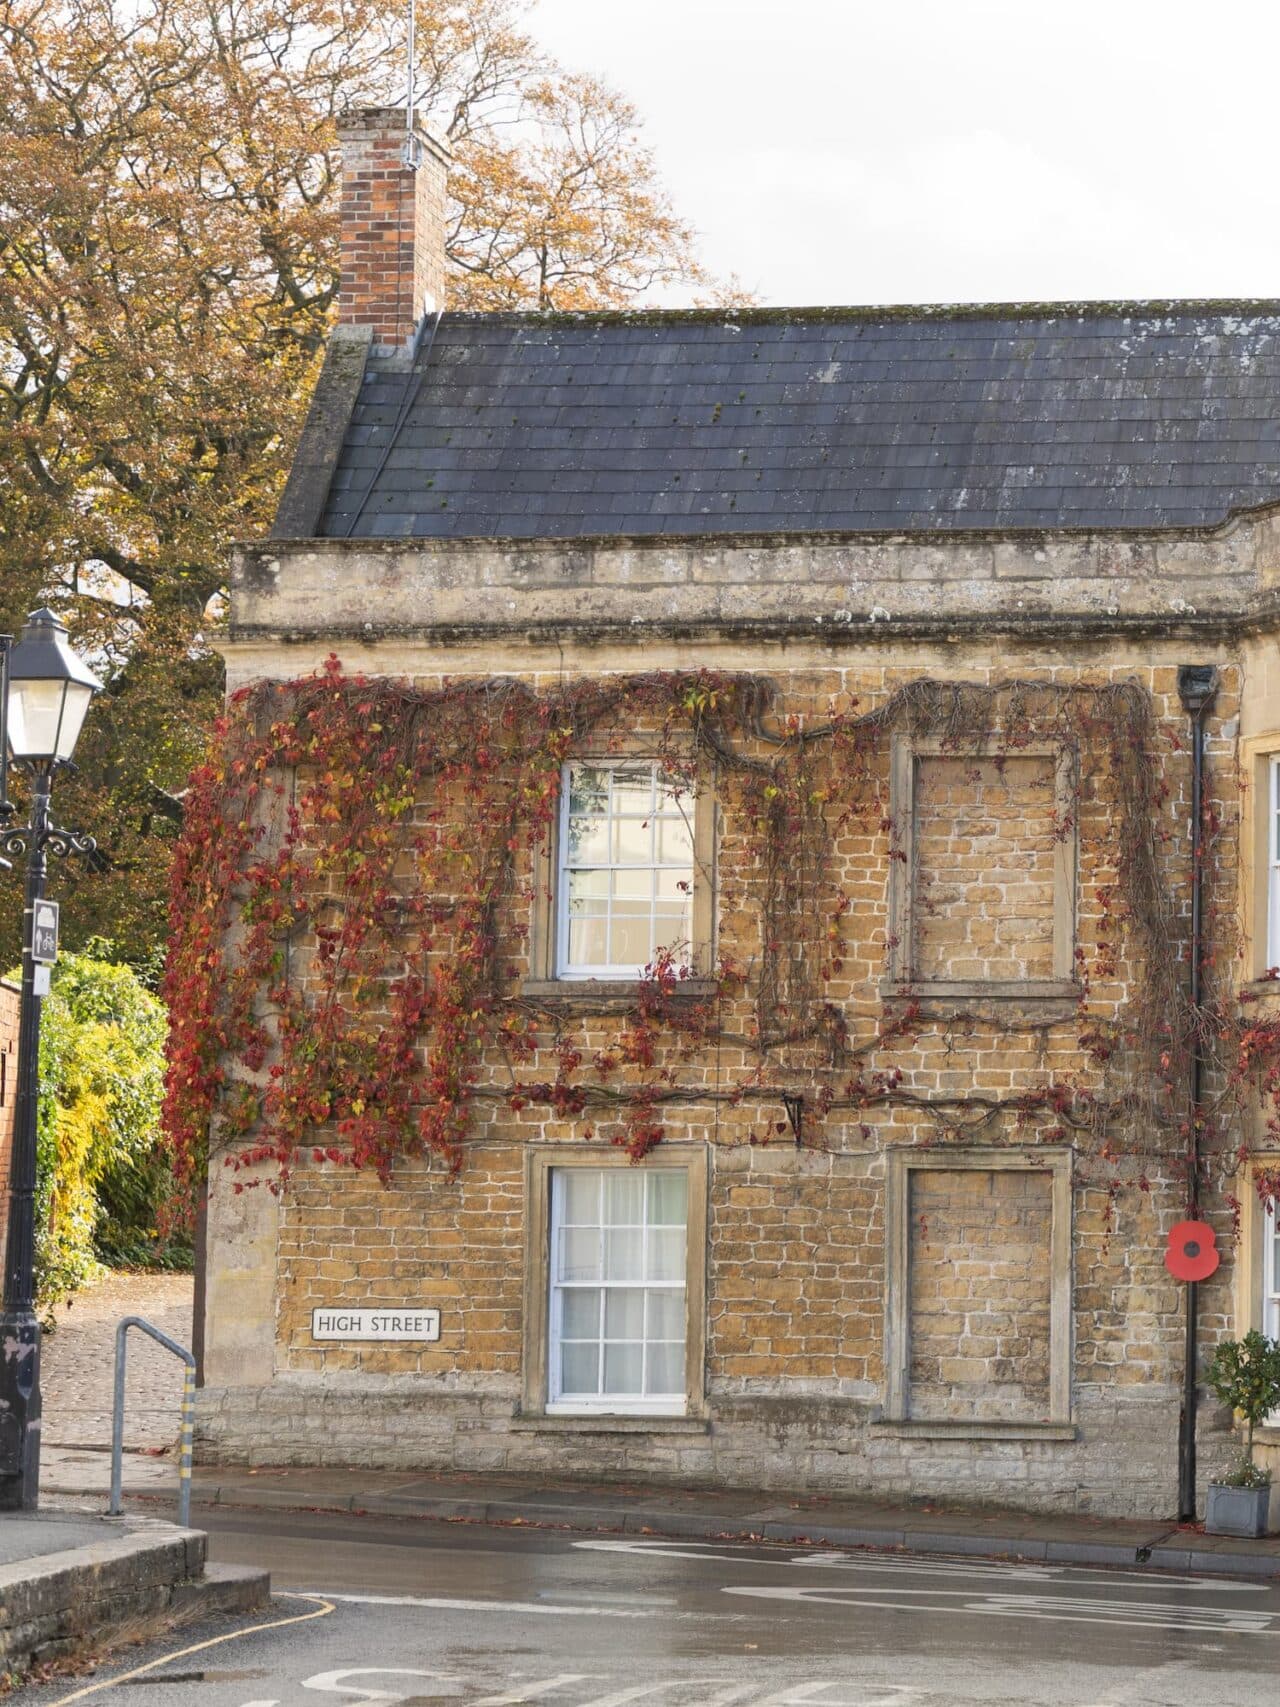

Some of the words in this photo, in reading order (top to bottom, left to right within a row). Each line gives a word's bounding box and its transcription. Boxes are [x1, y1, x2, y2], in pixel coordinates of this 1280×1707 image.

[318, 1316, 362, 1332] HIGH
[370, 1316, 435, 1333] STREET
[963, 1597, 1273, 1630] 20
